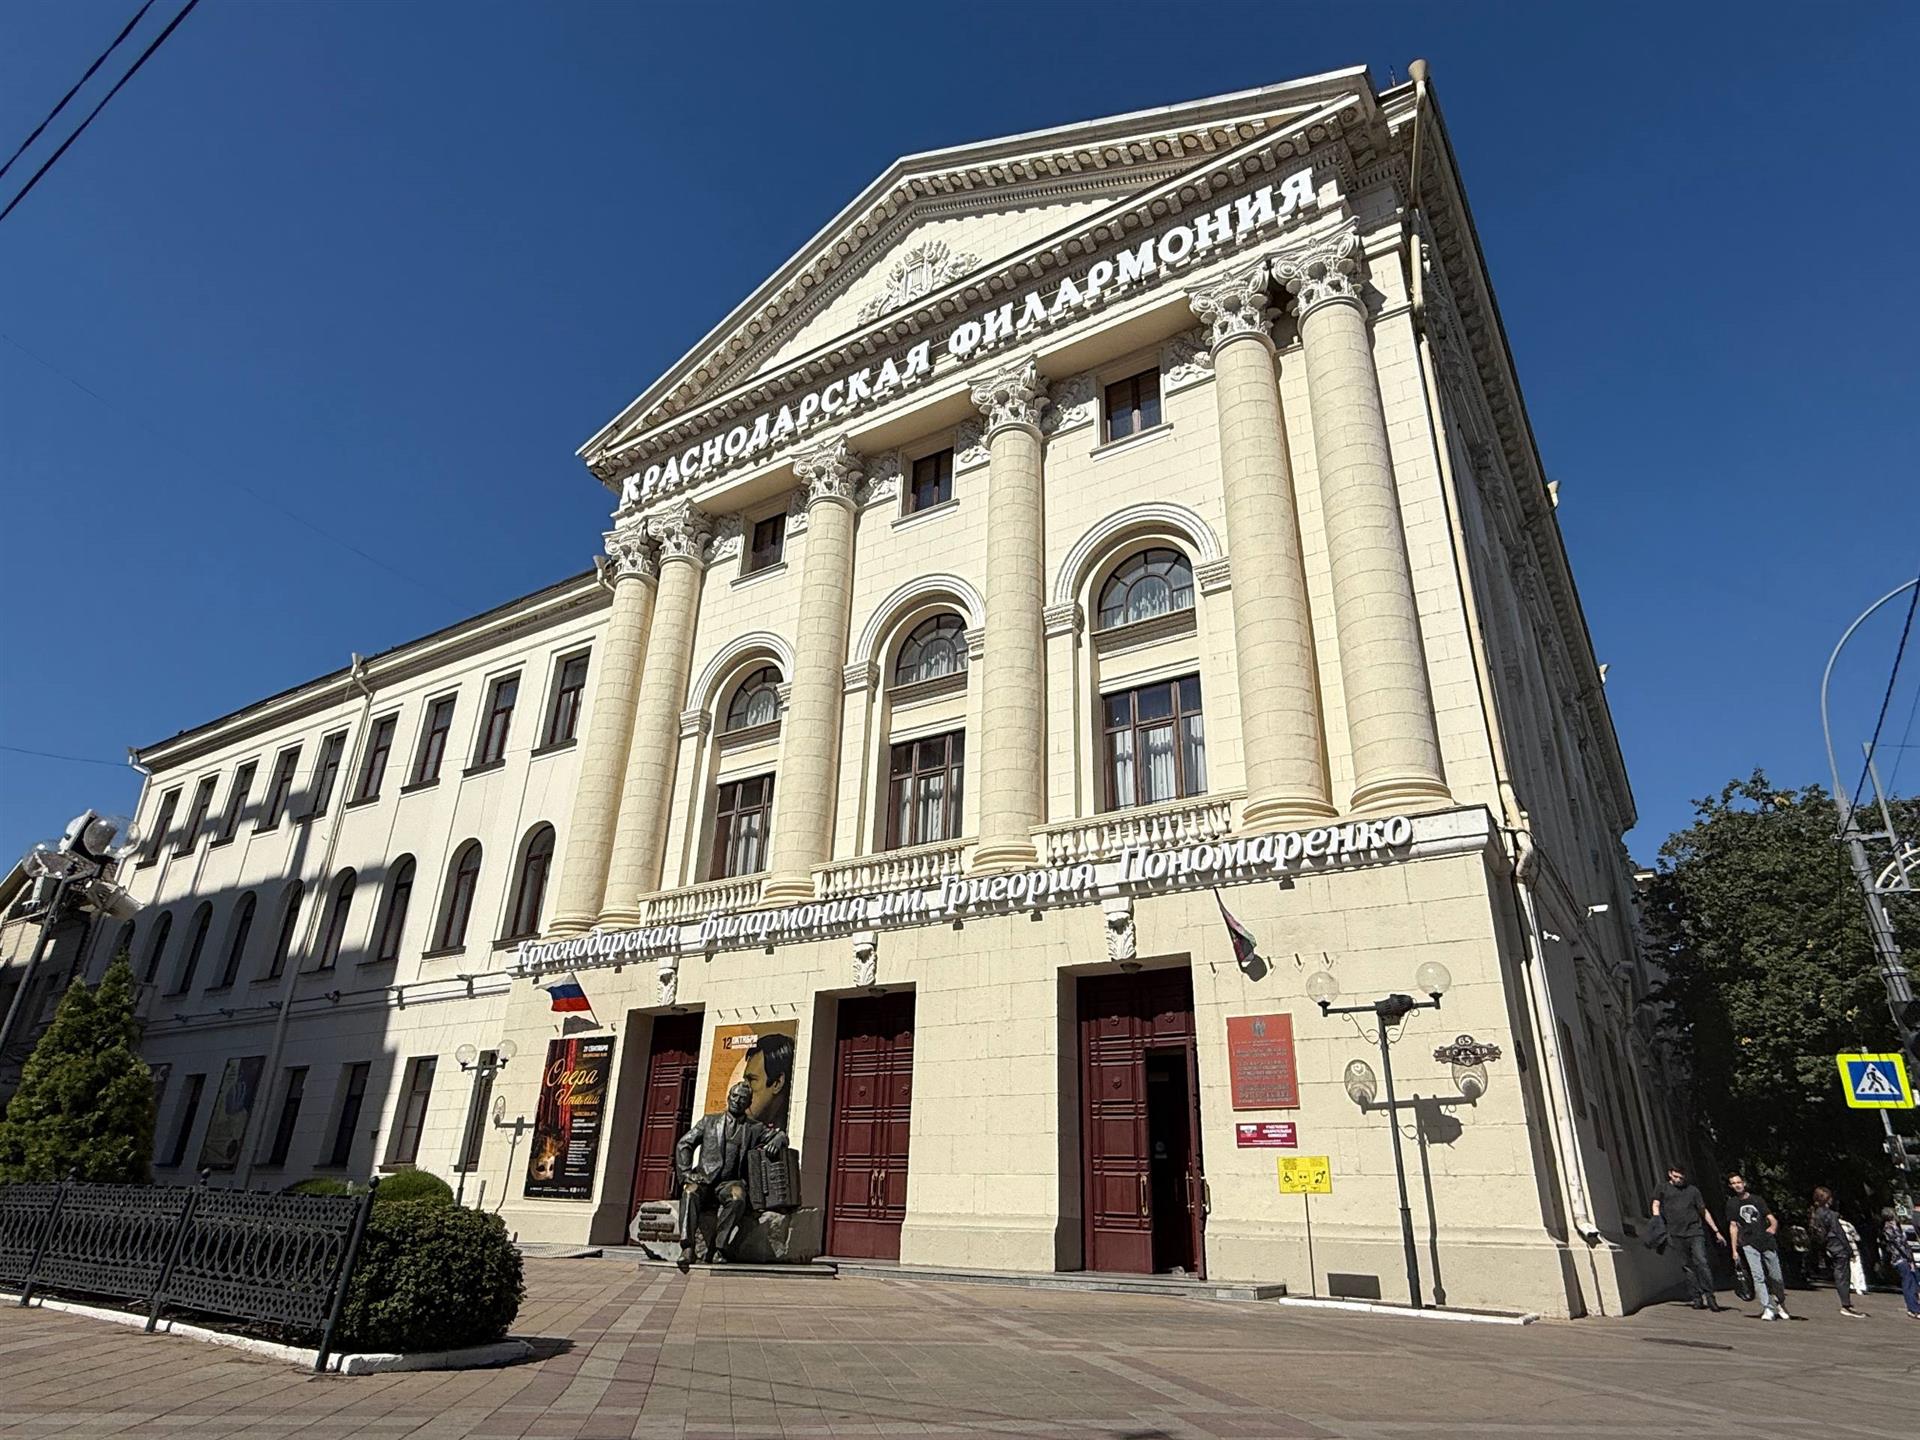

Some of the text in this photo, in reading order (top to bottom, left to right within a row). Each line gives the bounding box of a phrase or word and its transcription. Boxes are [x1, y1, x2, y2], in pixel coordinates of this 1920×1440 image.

[621, 167, 1316, 502] КРАСНОДАРСКАЯ ФИЛАРМОНИЯ
[516, 814, 1412, 969] Краснодарская филармония им. Григория Пономаренко
[722, 1036, 732, 1049] 12
[1457, 1036, 1472, 1045] 65
[547, 1058, 599, 1092] Опера
